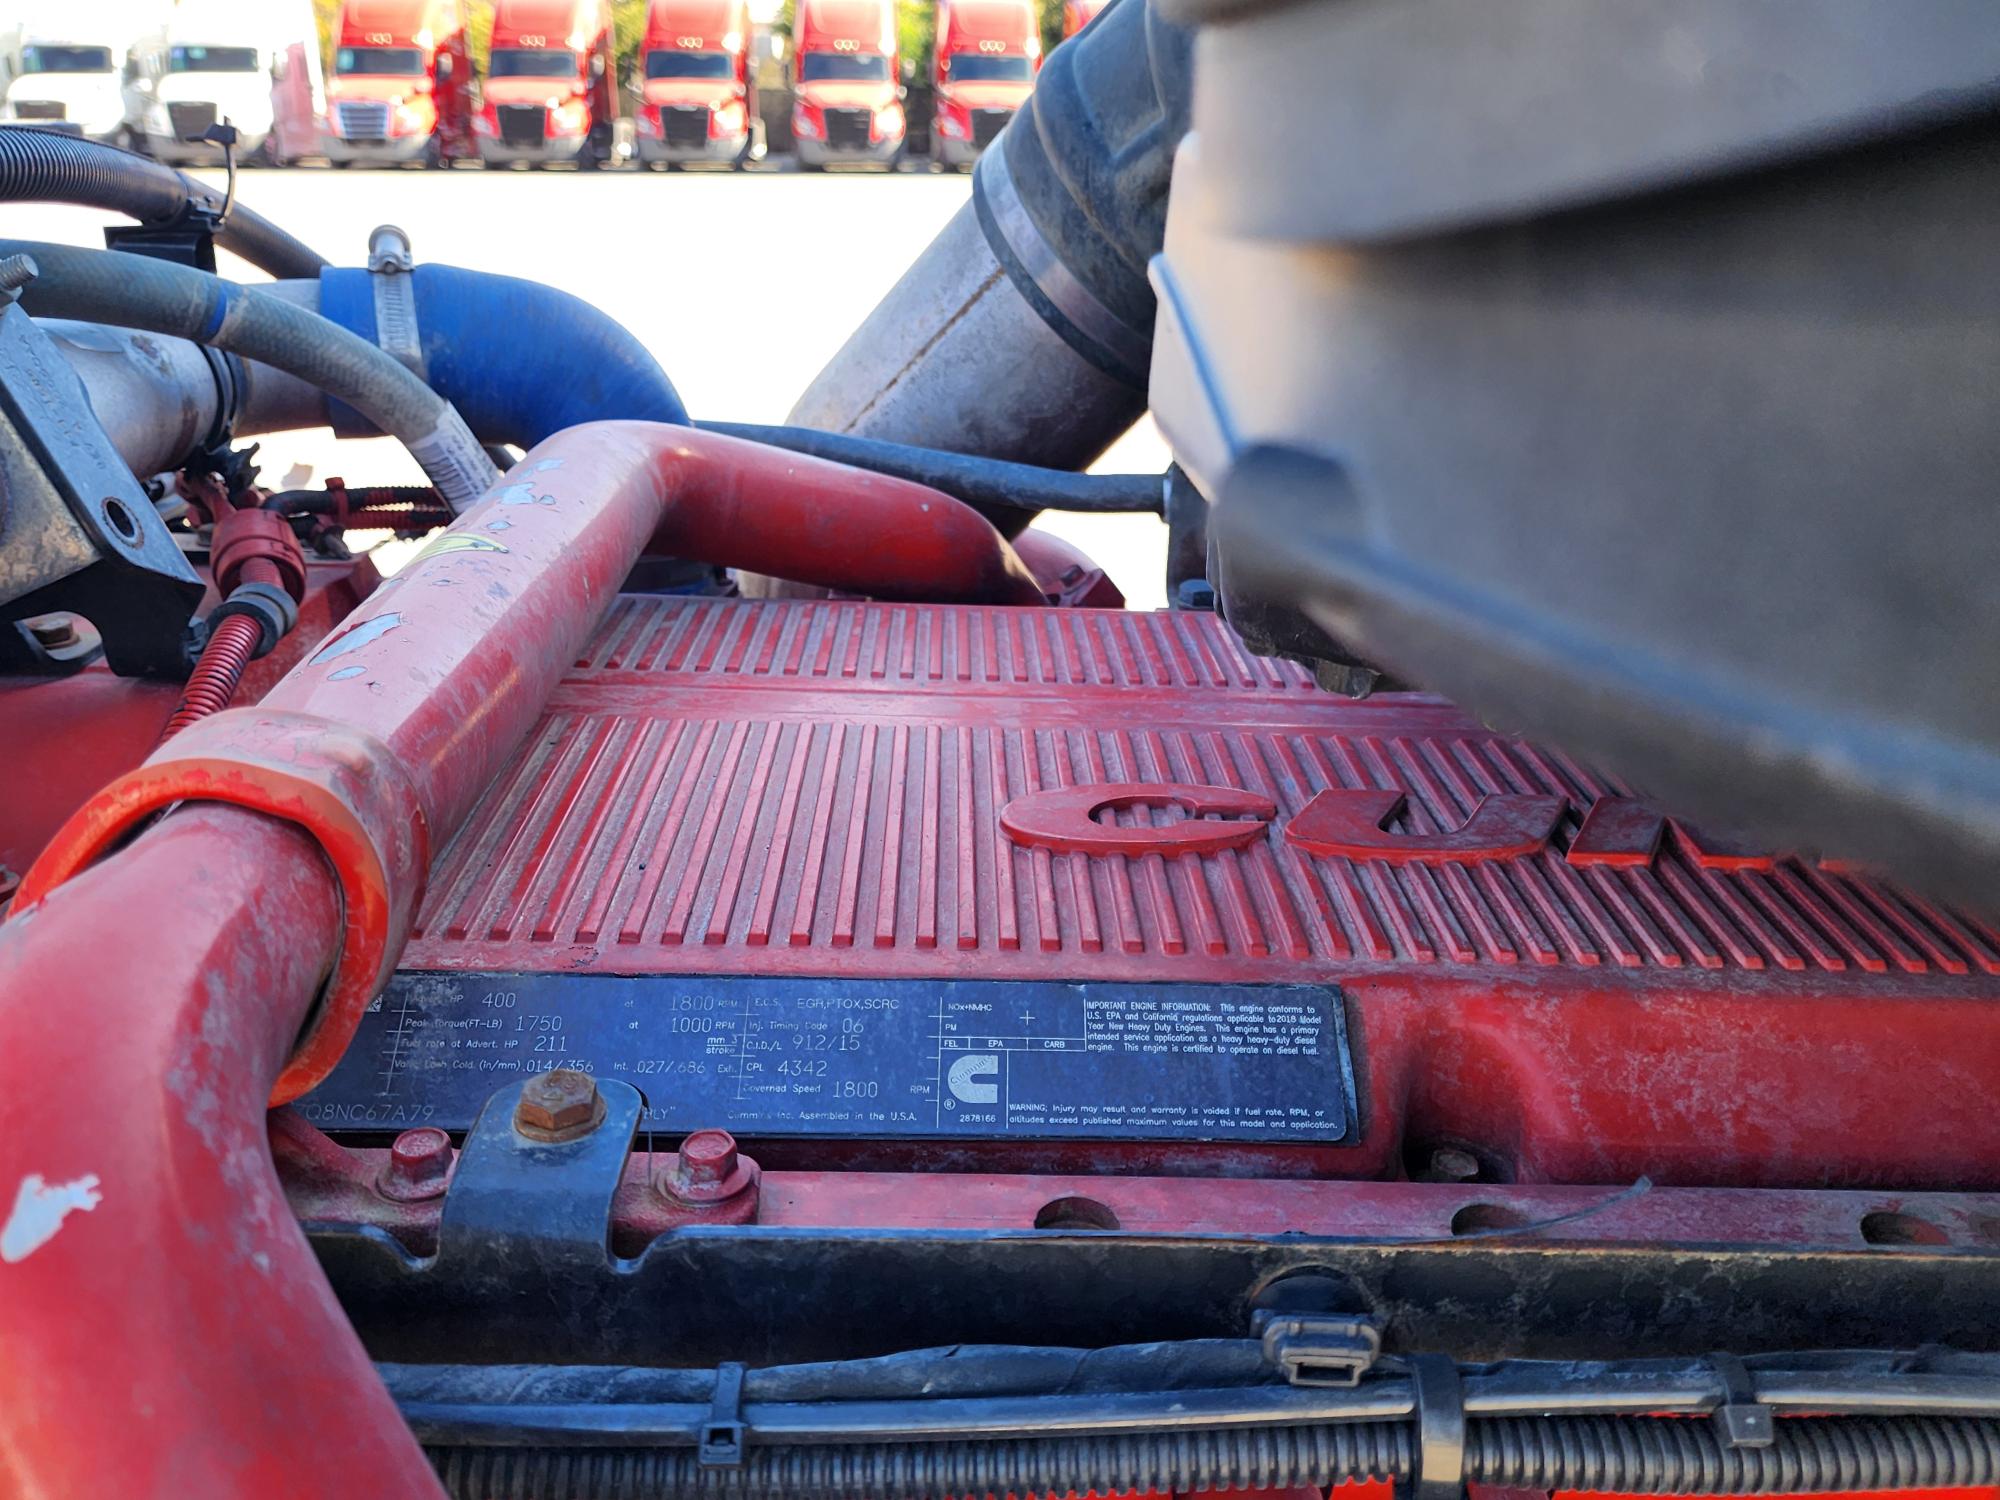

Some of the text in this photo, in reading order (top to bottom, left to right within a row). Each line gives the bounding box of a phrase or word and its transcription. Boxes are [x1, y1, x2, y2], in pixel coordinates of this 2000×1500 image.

[481, 992, 516, 1009] 400
[669, 995, 715, 1011] 1800
[718, 1000, 738, 1008] RPM
[948, 1003, 993, 1012] NOx+NMHC
[1086, 1001, 1316, 1015] IMPORTANT ENGINE INFORMATION: This engine conforms to
[515, 1015, 736, 1033] 1750 at 1000 RPM
[1086, 1011, 1102, 1020] U.S.
[1106, 1012, 1121, 1020] EPA
[1125, 1012, 1139, 1021] and
[1142, 1012, 1178, 1021] California
[1182, 1013, 1223, 1024] regulations
[1227, 1014, 1265, 1025] applicable
[1300, 1015, 1322, 1025] Model
[770, 1021, 799, 1032] Timing
[804, 1021, 829, 1031] Code
[842, 1018, 864, 1034] 06
[945, 1023, 957, 1032] PM
[1088, 1021, 1320, 1036] Year New Heavy Duty Engines. This engine has a primary
[450, 1040, 461, 1049] at
[465, 1039, 499, 1049] Advert.
[504, 1040, 519, 1049] HP
[534, 1035, 568, 1052] 211
[792, 1034, 861, 1051] 912/15
[943, 1039, 958, 1049] FEL
[988, 1039, 1004, 1049] EPA
[1044, 1040, 1066, 1049] CARB
[1088, 1032, 1120, 1041] intended
[1123, 1033, 1150, 1041] service
[1154, 1033, 1195, 1044] application
[1221, 1034, 1243, 1045] heavy
[1247, 1035, 1291, 1046] heavy-duty
[1294, 1036, 1317, 1045] diesel
[706, 1045, 736, 1055] stroke
[1087, 1042, 1320, 1056] engine. This engine is certified to operate on diesel fuel.
[480, 1059, 521, 1072] (in/mm)
[633, 1060, 706, 1074] .027/.686
[746, 1060, 828, 1077] CPL 4342
[792, 1083, 821, 1096] Speed
[833, 1080, 879, 1099] 1800
[910, 1084, 931, 1095] RPM
[799, 1110, 850, 1121] Assembled
[854, 1111, 864, 1120] in
[869, 1111, 885, 1121] the
[890, 1111, 918, 1121] U.S.A.
[1052, 1104, 1076, 1114] Injury
[1080, 1105, 1098, 1114] may
[1102, 1105, 1126, 1113] result
[1130, 1106, 1146, 1114] and
[1151, 1106, 1187, 1115] warranty
[1191, 1107, 1199, 1115] is
[1203, 1106, 1230, 1116] voided
[1245, 1107, 1261, 1116] fuel
[1314, 1109, 1325, 1117] or
[960, 1114, 996, 1123] 2878166
[1009, 1114, 1338, 1130] altitudes exceed published maximum values for this model and application.
